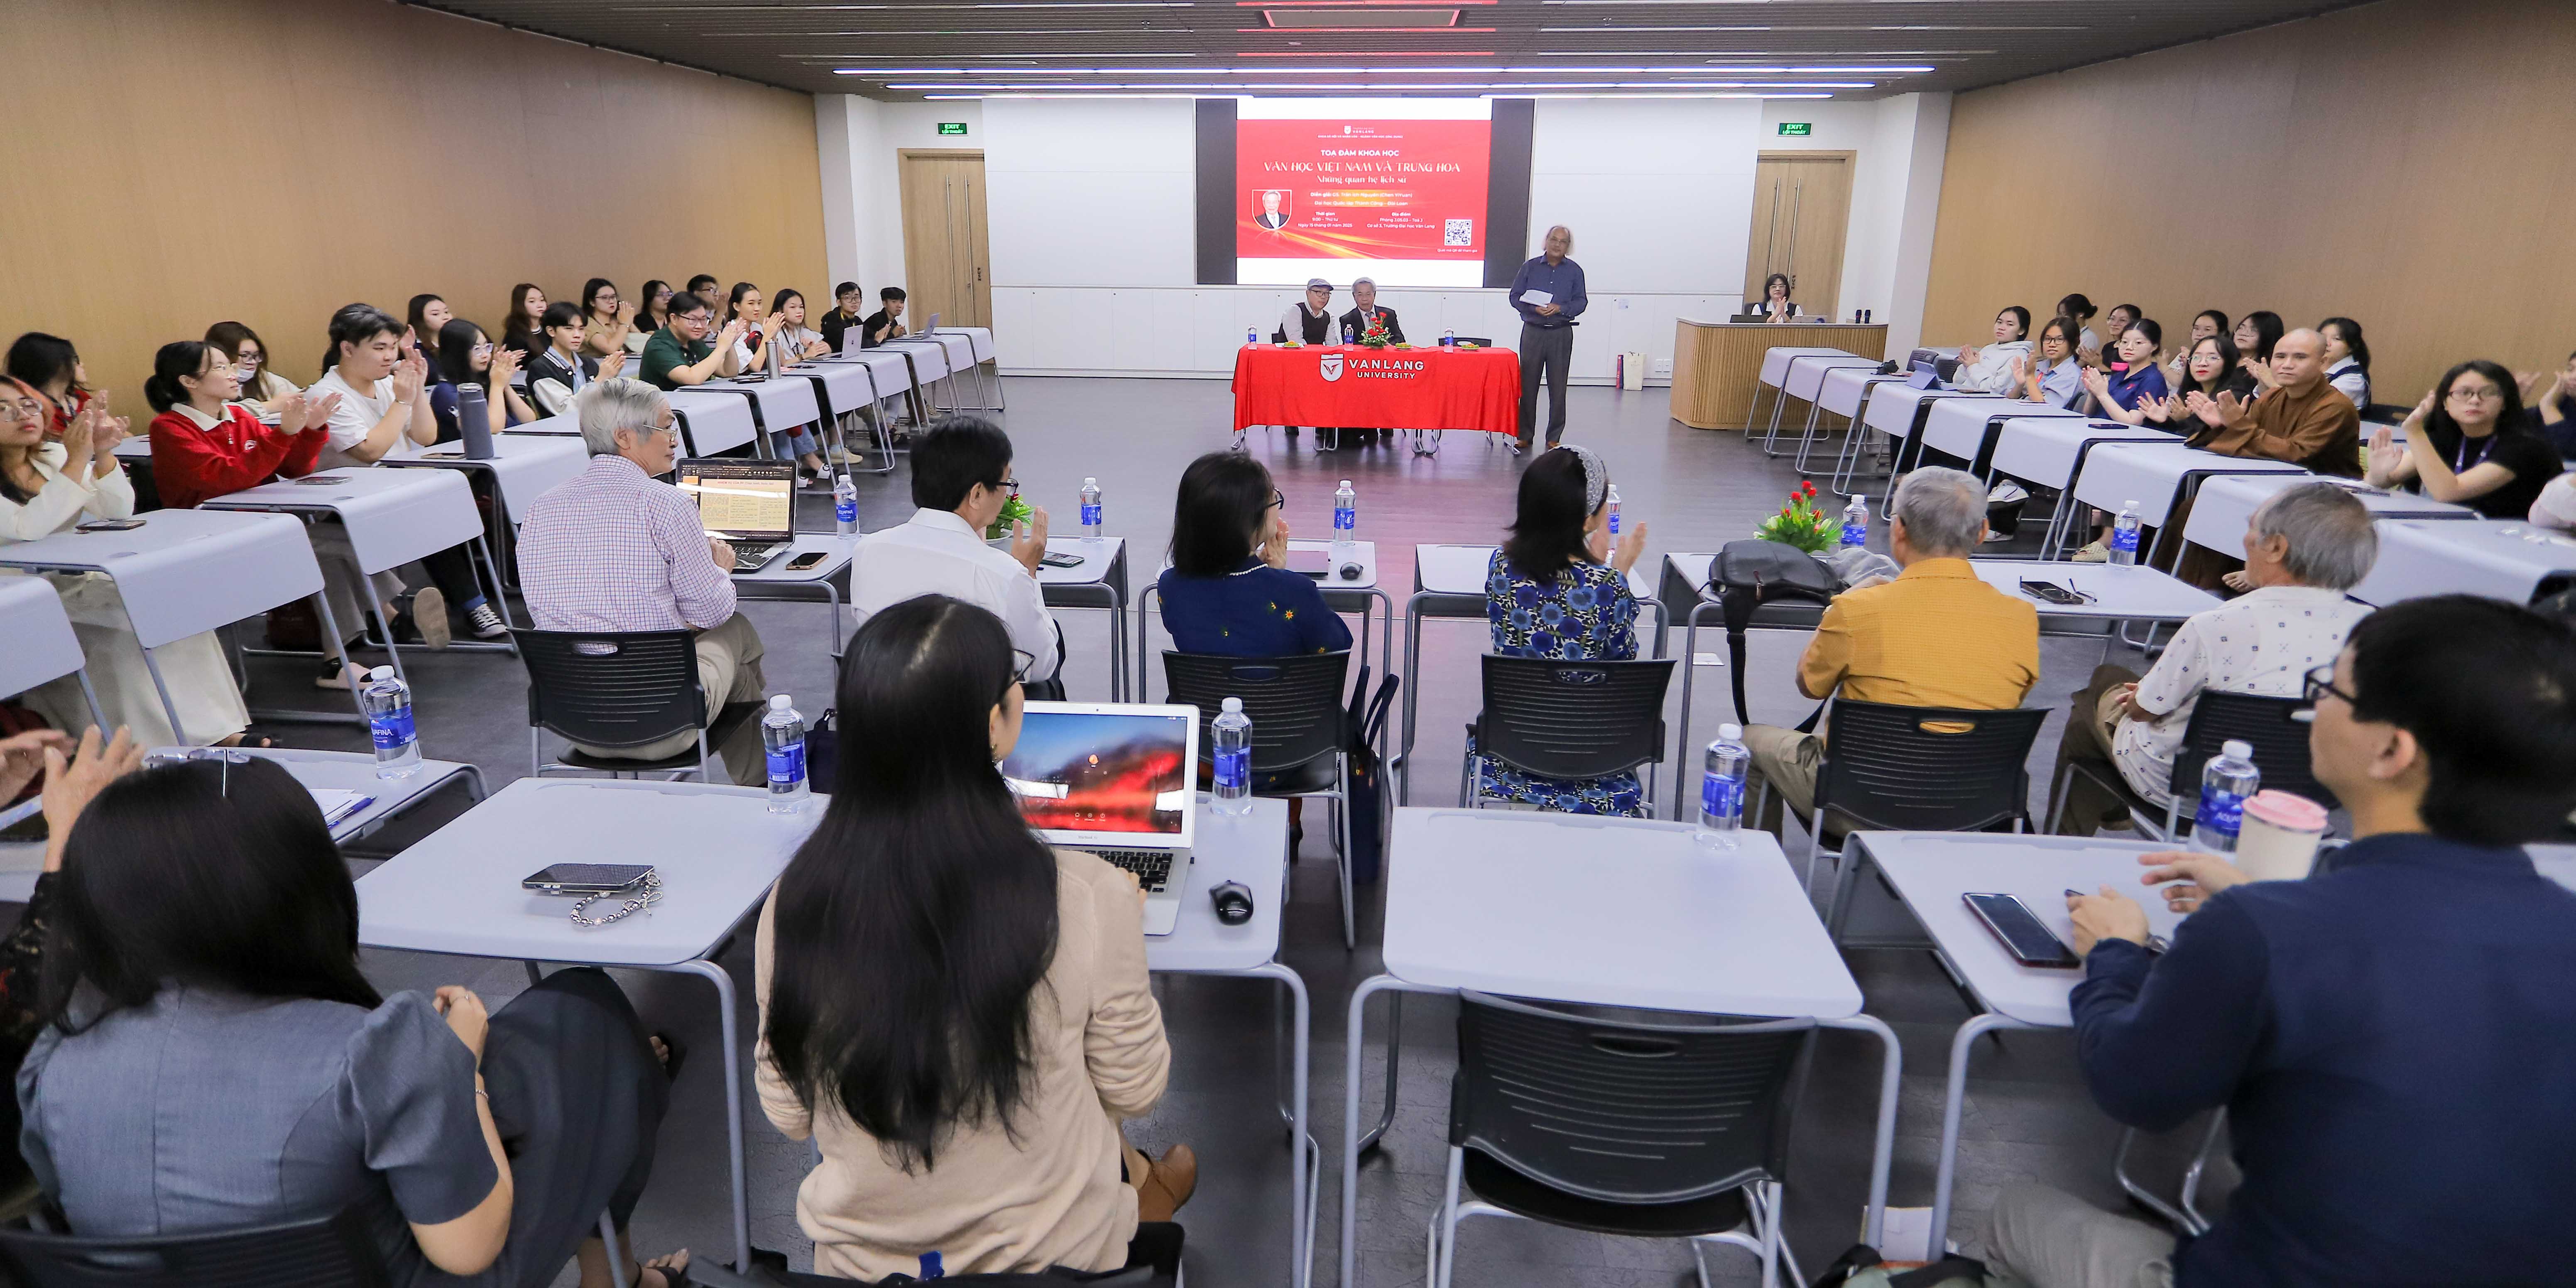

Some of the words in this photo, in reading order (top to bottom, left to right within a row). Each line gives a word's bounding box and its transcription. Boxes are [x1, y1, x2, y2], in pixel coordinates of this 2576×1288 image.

[1264, 161, 1288, 171] VĂN
[1291, 162, 1313, 173] HỌC
[1317, 162, 1342, 173] VIỆT
[1345, 162, 1372, 171] NAM
[1376, 160, 1392, 171] VÀ
[1396, 163, 1432, 172] TRUNG
[1436, 163, 1460, 172] HOA
